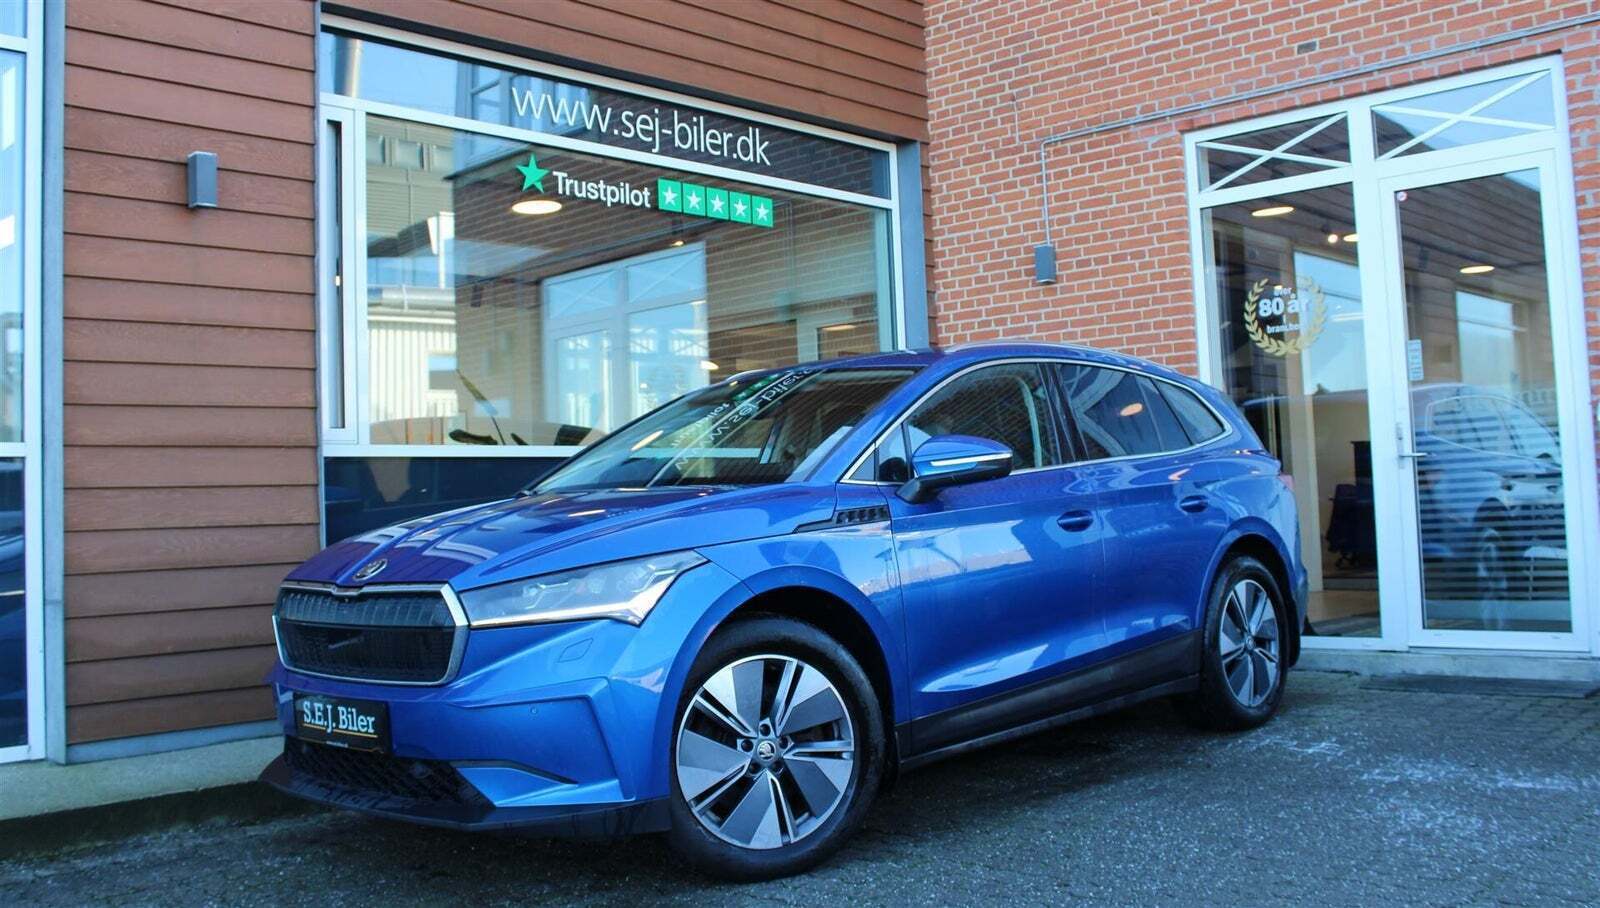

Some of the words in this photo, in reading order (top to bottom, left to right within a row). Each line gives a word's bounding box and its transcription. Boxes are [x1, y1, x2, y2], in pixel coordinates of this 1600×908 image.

[512, 87, 771, 166] www.sej-biler.dk
[552, 170, 651, 208] Trustpilot
[1259, 297, 1285, 317] 80
[1287, 293, 1309, 313] år
[303, 700, 336, 733] S.E.J.
[338, 706, 375, 733] Biler
